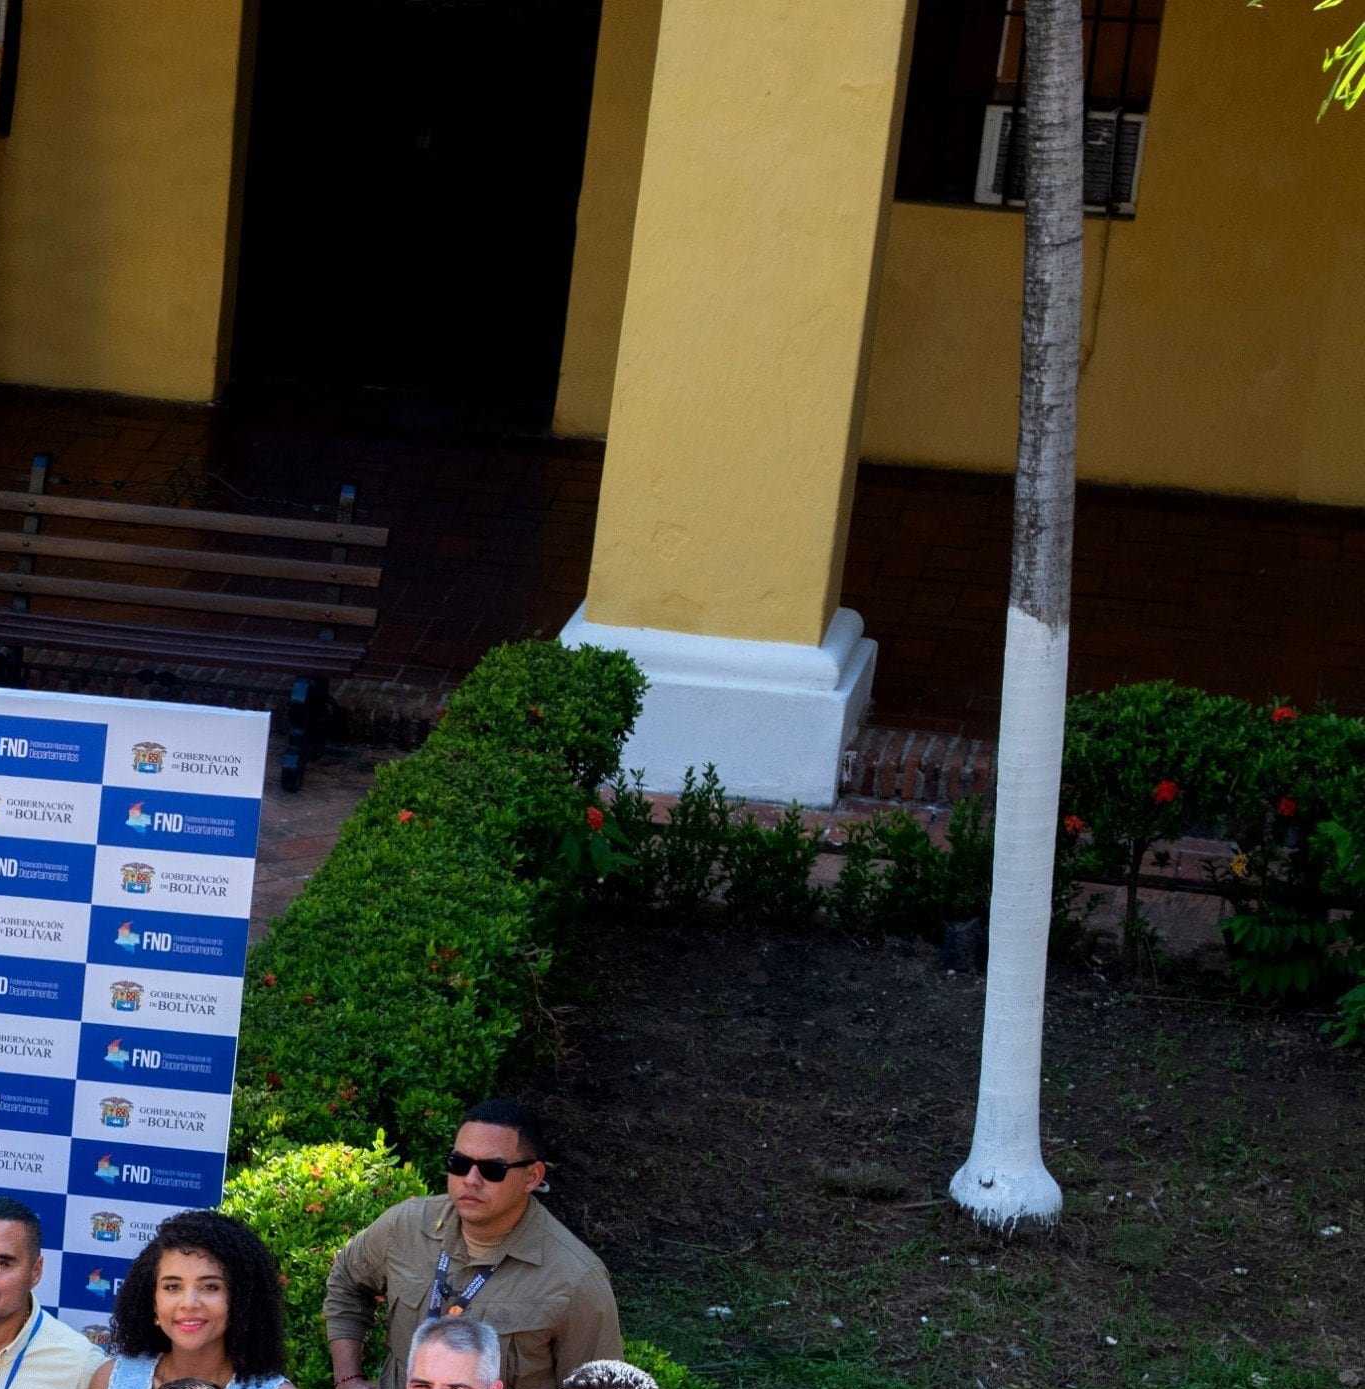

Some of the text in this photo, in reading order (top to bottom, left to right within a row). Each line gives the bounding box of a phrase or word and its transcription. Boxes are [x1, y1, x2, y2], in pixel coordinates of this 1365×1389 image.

[28, 748, 78, 762] Departamentos
[171, 751, 240, 765] GOBERNACIÓN
[179, 762, 238, 777] BOLÍVAR
[6, 797, 74, 810] GOBERNACIÓN
[14, 807, 72, 822] BOLÍVAR
[152, 811, 183, 833] FND
[182, 823, 234, 837] Departamentos
[18, 868, 68, 882] Departamentos
[160, 872, 228, 885] GOBERNACIÓN
[168, 882, 227, 898] BOLÍVAR
[5, 926, 62, 941] BOLÍVAR
[142, 930, 172, 952] FND
[9, 986, 59, 1000] Departamentos
[149, 990, 217, 1004] GOBERNACIÓN
[157, 1001, 215, 1016] BOLÍVAR
[131, 1048, 161, 1069] FND
[139, 1107, 206, 1120] GOBERNACIÓN
[147, 1117, 204, 1132] BOLÍVAR
[121, 1163, 151, 1184] FND
